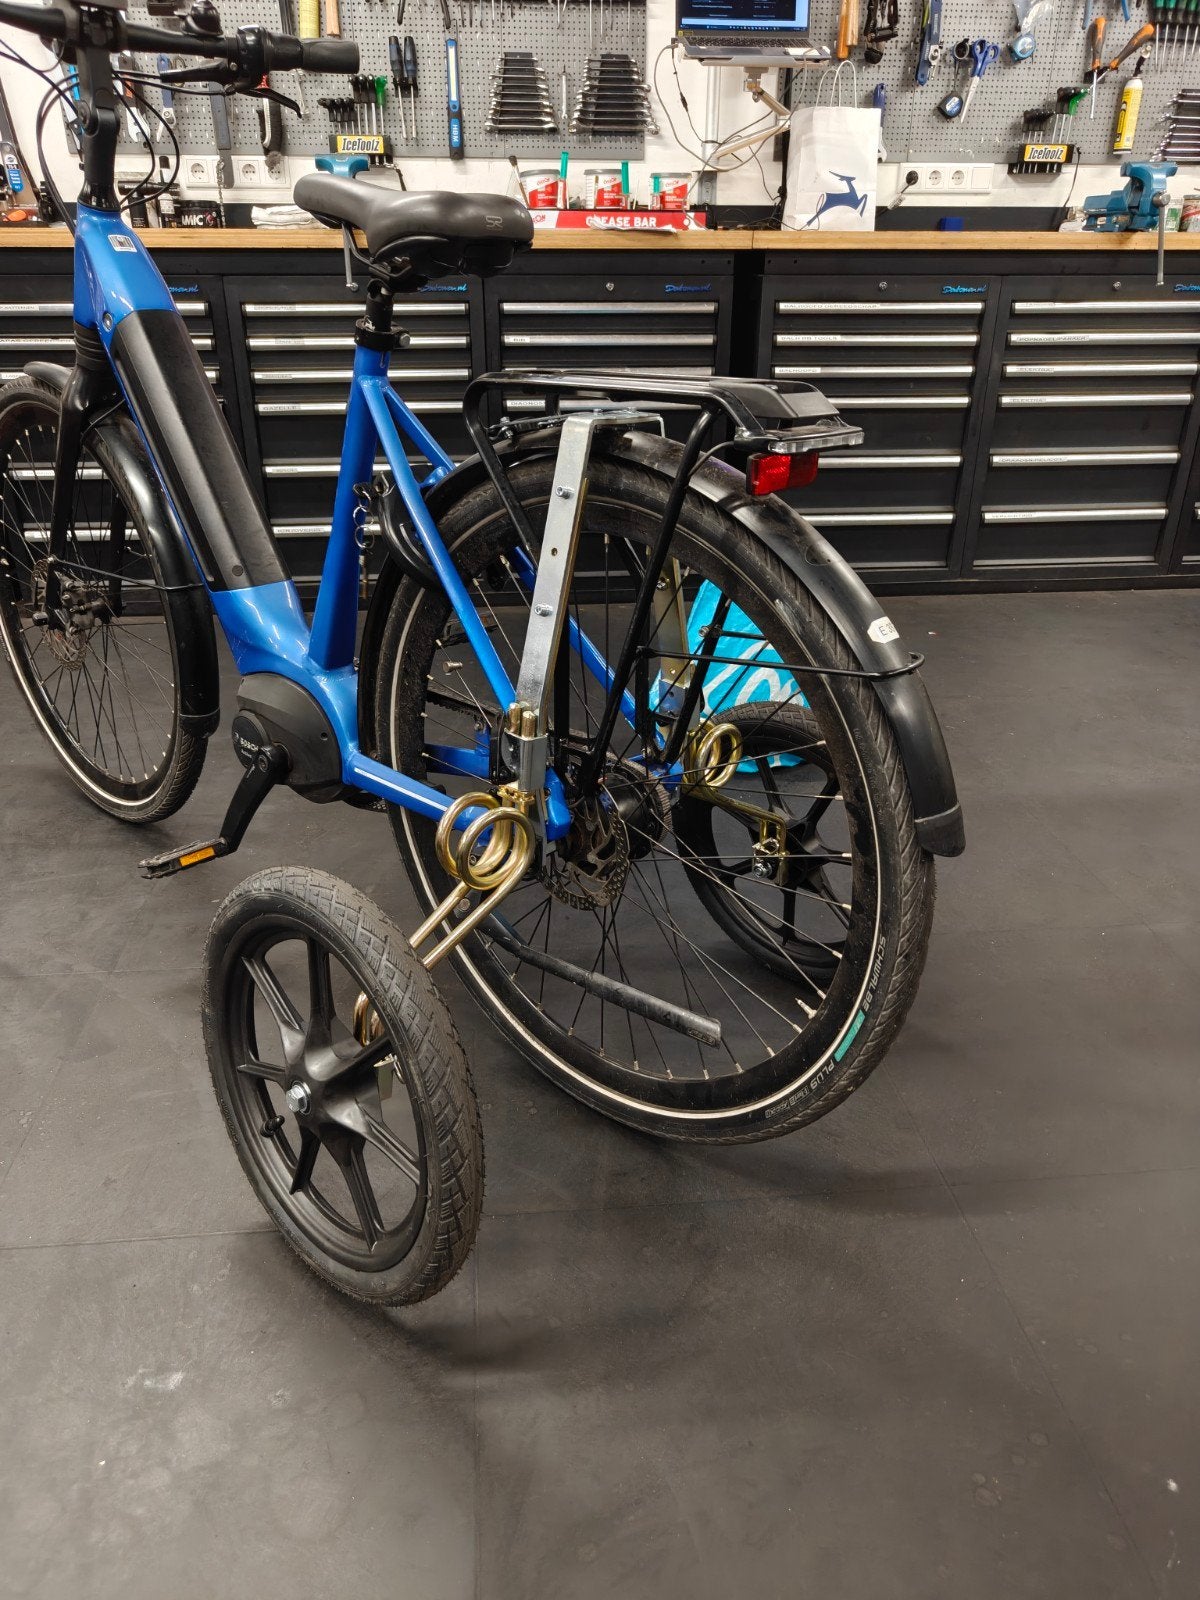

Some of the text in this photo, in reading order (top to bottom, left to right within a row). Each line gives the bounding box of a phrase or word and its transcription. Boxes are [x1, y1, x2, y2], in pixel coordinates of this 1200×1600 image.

[452, 124, 460, 142] HBM
[341, 137, 380, 152] IceToolz
[1028, 146, 1064, 161] IceToolz
[633, 216, 657, 228] BAR
[862, 935, 886, 1012] SCHWALBE
[810, 1060, 835, 1090] PLUS
